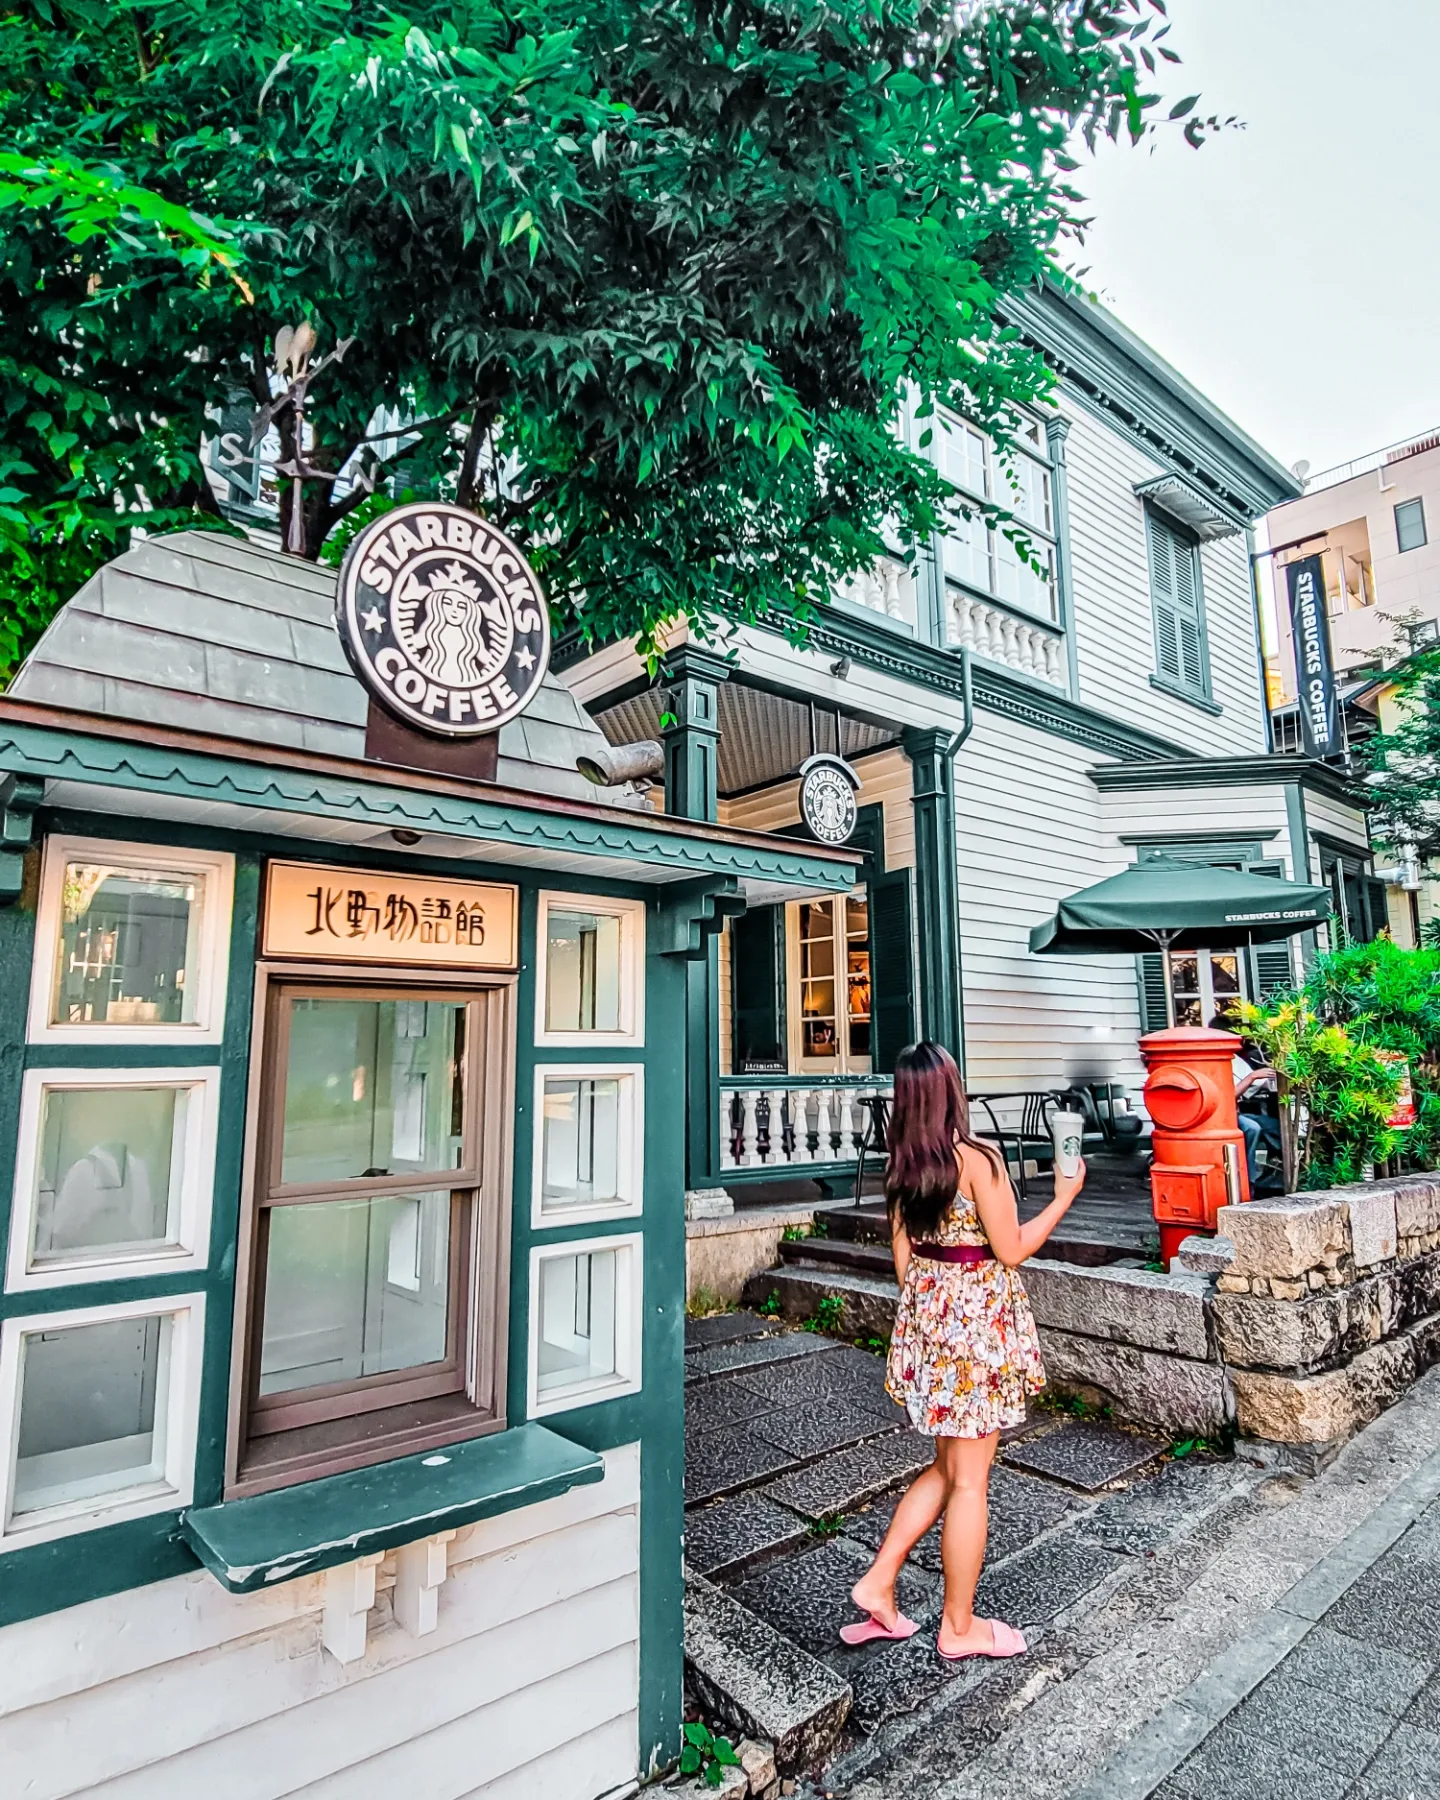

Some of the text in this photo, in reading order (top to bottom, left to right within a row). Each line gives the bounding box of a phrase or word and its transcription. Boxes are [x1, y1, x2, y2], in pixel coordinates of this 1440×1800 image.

[360, 515, 541, 634] STARBUCKS
[374, 647, 519, 722] COFFEE
[1298, 571, 1329, 745] STARBUCKS COFFEE
[806, 771, 854, 808] STARBUCKS
[811, 816, 848, 840] COFFEE
[305, 887, 486, 946] 北野物語館
[1225, 909, 1317, 922] STARBUCKS COFFEE
